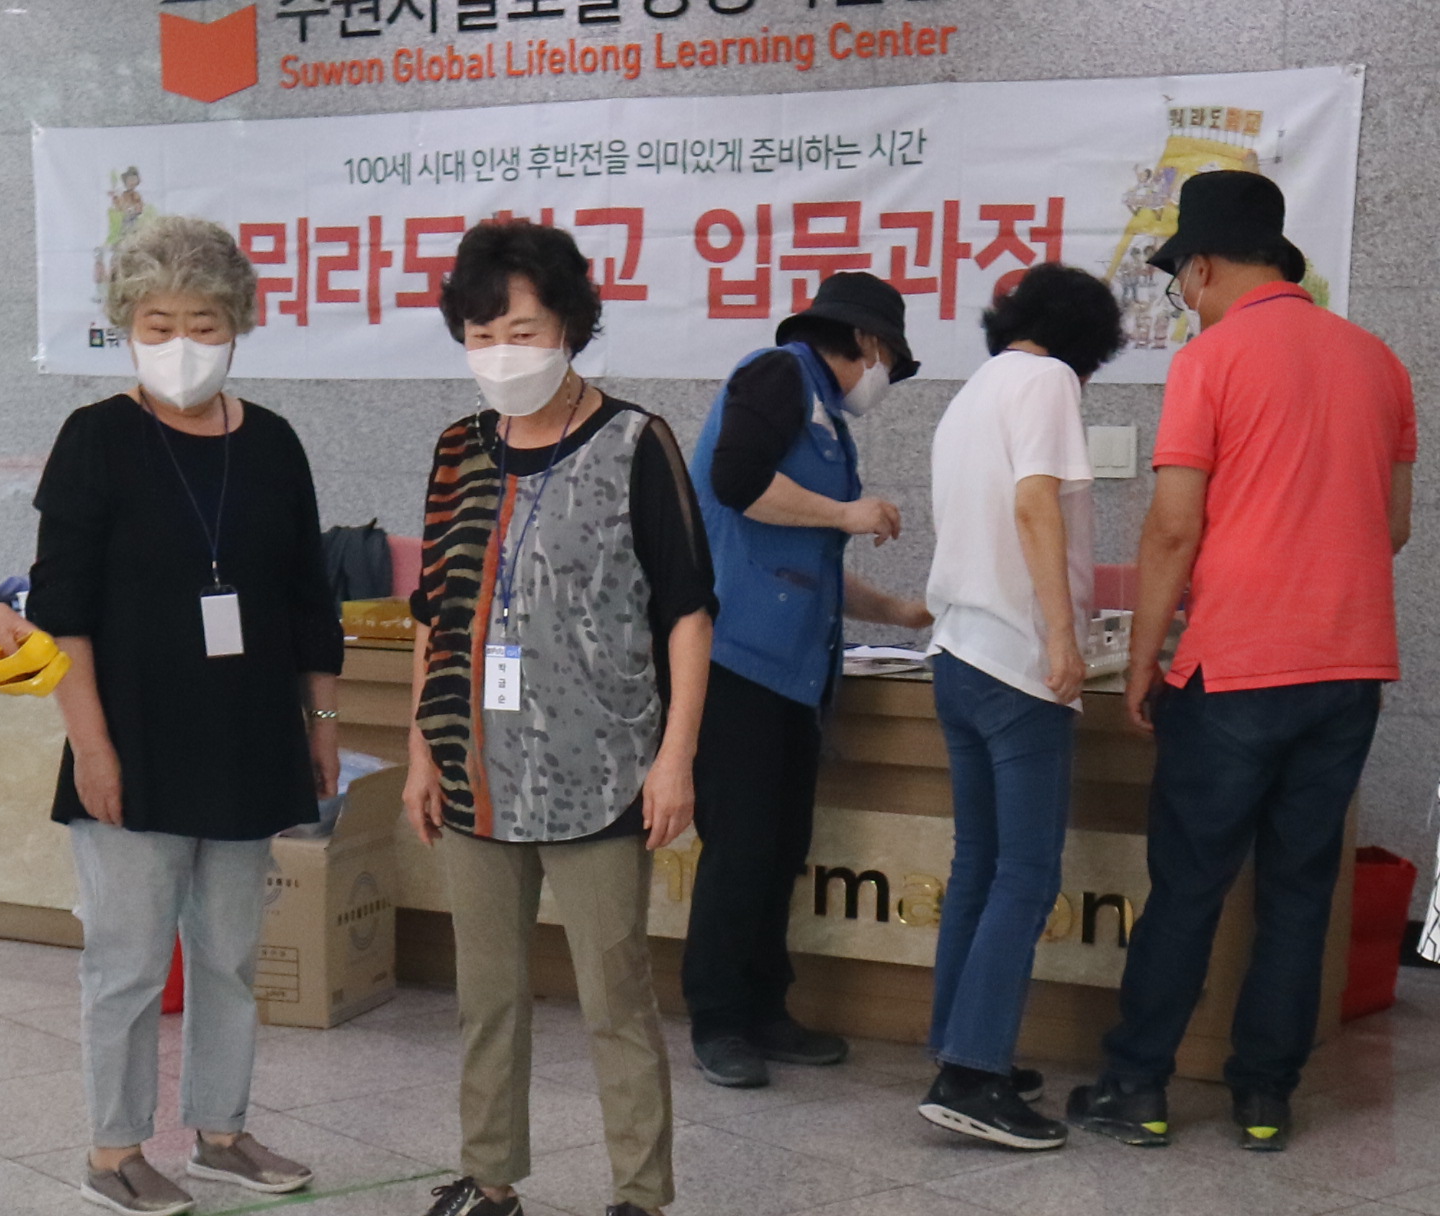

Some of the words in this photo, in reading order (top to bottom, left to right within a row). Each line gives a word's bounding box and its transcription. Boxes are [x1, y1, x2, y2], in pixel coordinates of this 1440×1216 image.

[280, 54, 385, 89] Suwon
[392, 43, 495, 83] Global
[506, 38, 642, 80] Lifelong
[655, 27, 815, 71] Learning
[828, 21, 958, 59] Center
[344, 152, 411, 185] 100세
[418, 149, 465, 184] 시대
[472, 146, 521, 182] 인생
[527, 139, 630, 178] 후반전을
[636, 138, 742, 174] 의미있게
[749, 134, 862, 173] 준비하는
[868, 128, 927, 166] 시간
[239, 207, 649, 327] 뭐라도교
[693, 196, 1065, 320] 입문과정
